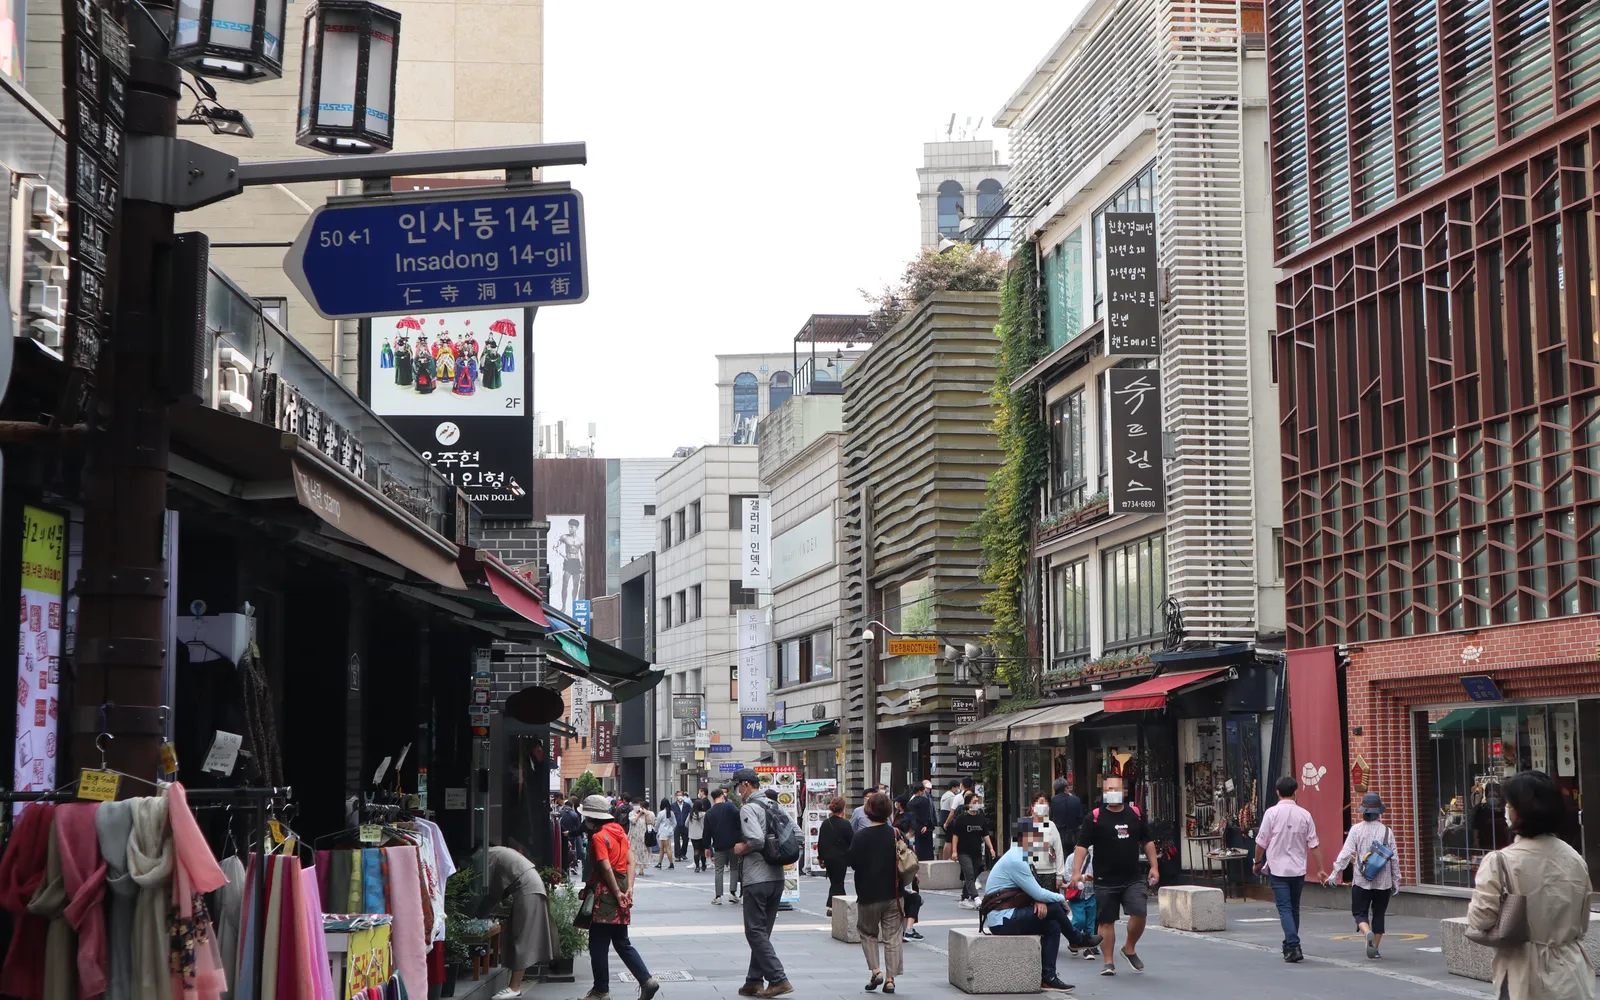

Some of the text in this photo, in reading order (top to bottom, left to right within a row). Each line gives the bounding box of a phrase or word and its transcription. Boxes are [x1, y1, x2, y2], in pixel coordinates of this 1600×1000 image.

[398, 201, 571, 244] 인사동14길
[1108, 220, 1153, 236] 친환경패션
[320, 230, 342, 247] 50
[395, 242, 572, 273] Insadong 14-gil
[1109, 244, 1146, 257] 자연소재
[1110, 266, 1146, 280] 자연염색
[1111, 313, 1129, 327] 린넨
[1111, 334, 1157, 349] 핸드메이드
[505, 397, 521, 408] 2F
[462, 471, 505, 489] 인형
[750, 500, 760, 576] 갤러리 인덱스
